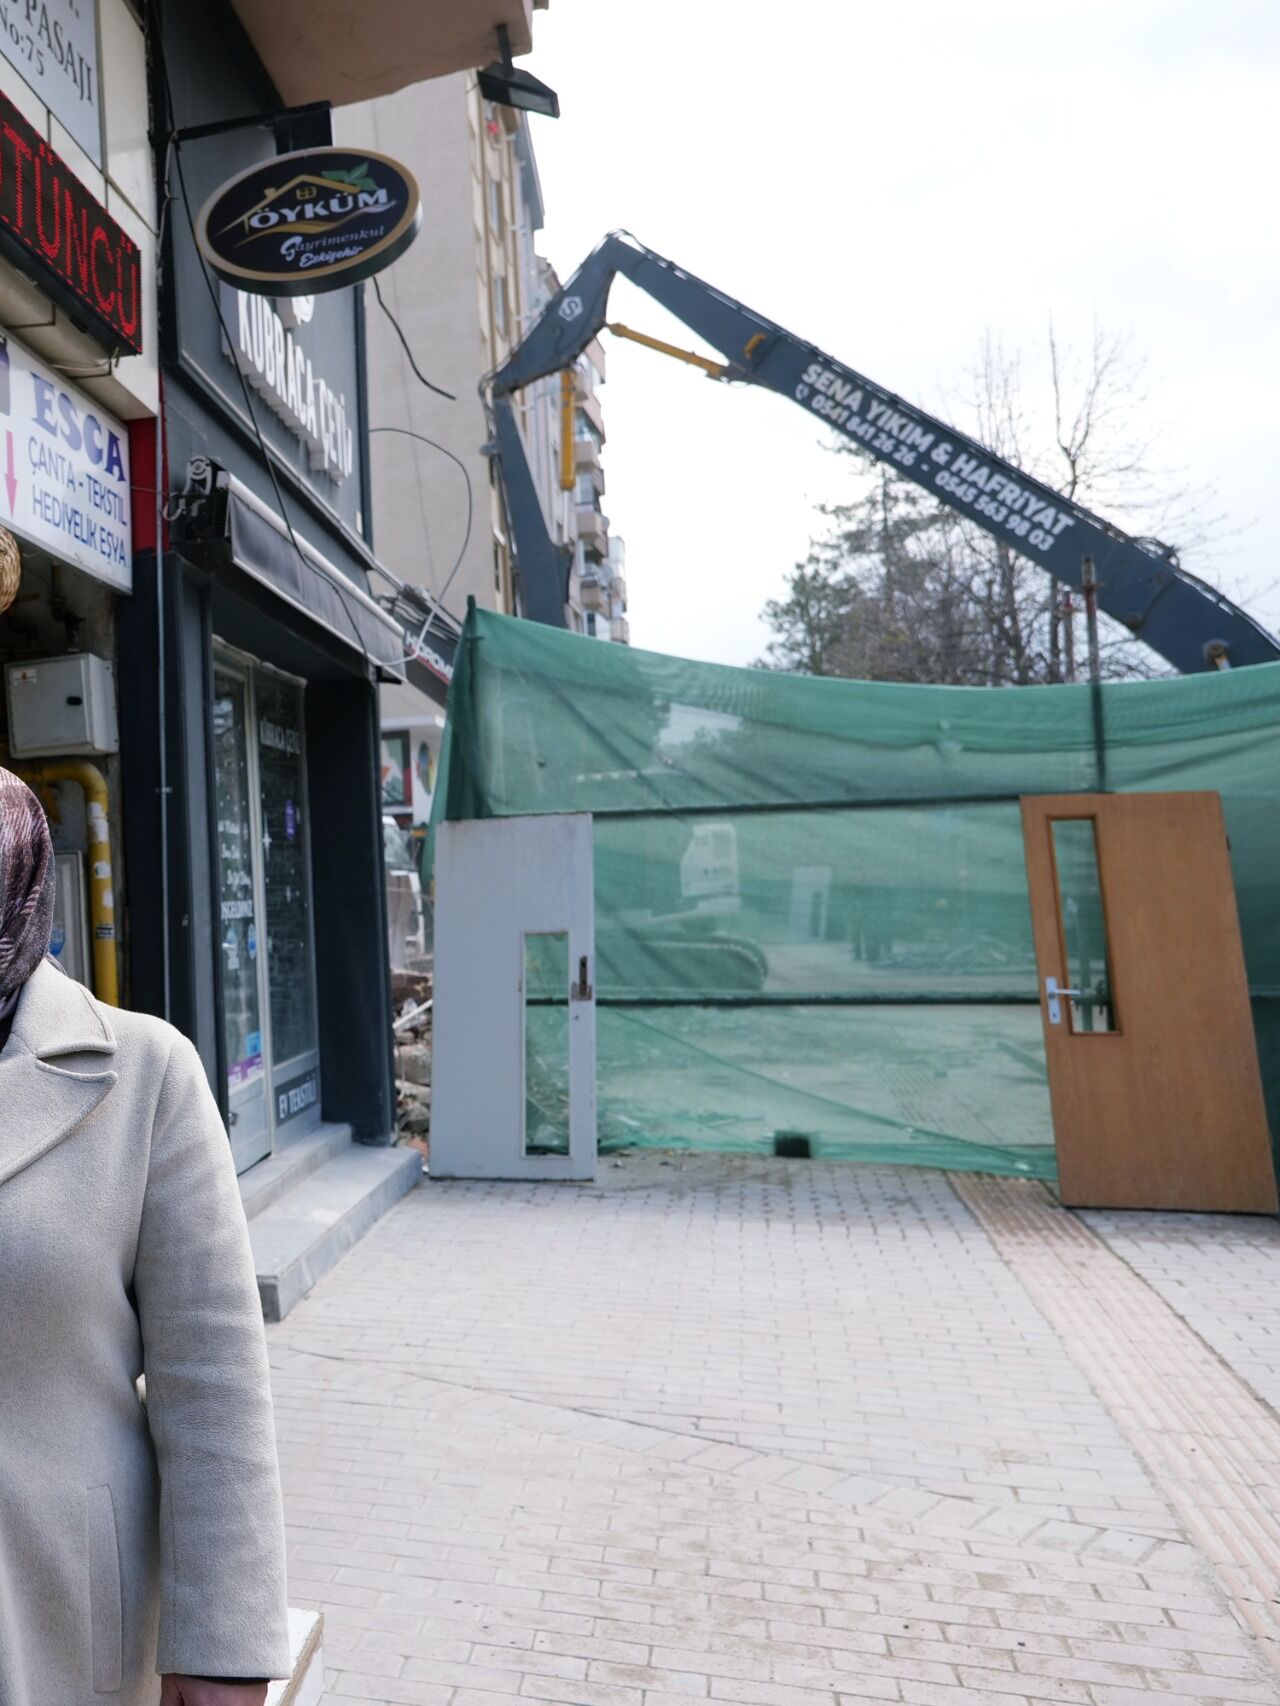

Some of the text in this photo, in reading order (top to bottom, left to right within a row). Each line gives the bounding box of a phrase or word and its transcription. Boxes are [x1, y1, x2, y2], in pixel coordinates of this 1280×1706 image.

[249, 188, 389, 229] ÖYKÜM
[28, 436, 77, 493] ÇANTA
[31, 372, 127, 482] ESCA
[801, 363, 1076, 536] SENA YIKIM & HAFRİYAT
[811, 394, 850, 425] 0541
[845, 415, 877, 442] 841
[871, 431, 897, 454] 26
[892, 445, 918, 467] 26
[934, 470, 979, 503] 0545
[973, 494, 1009, 523] 563
[1005, 513, 1032, 537] 98
[1028, 528, 1056, 552] 03
